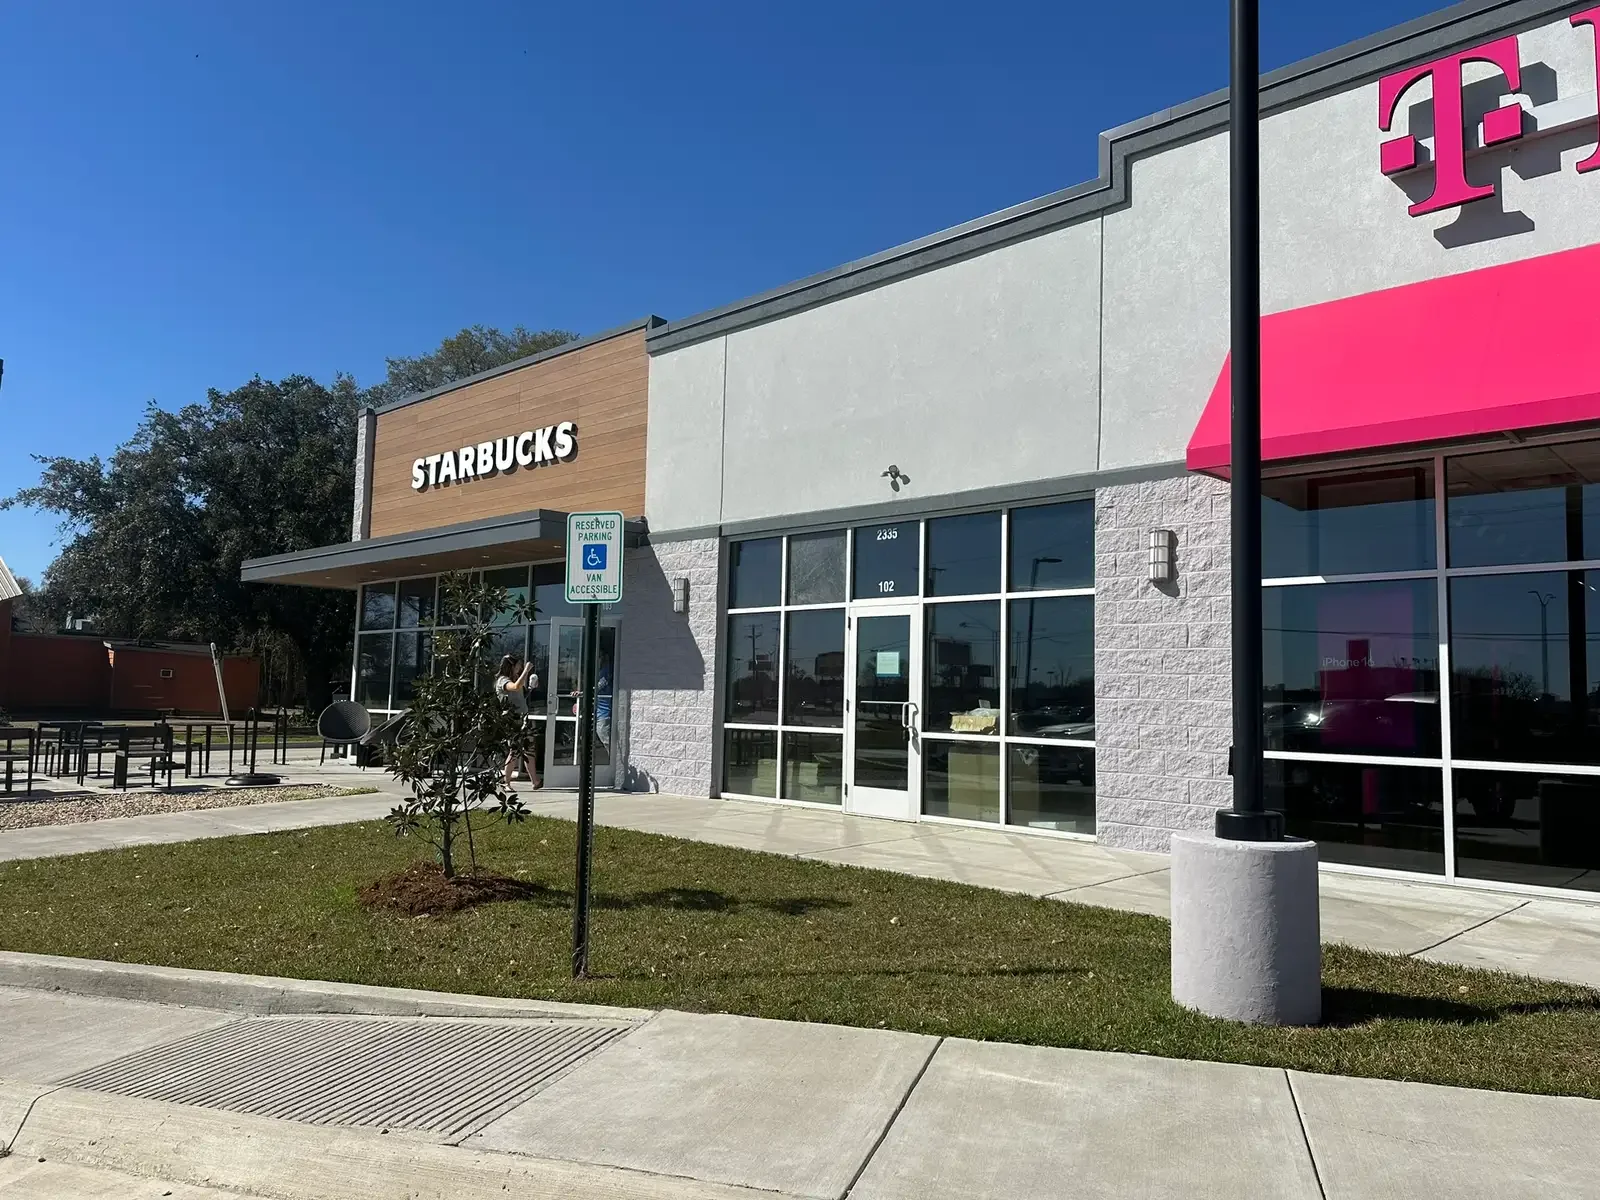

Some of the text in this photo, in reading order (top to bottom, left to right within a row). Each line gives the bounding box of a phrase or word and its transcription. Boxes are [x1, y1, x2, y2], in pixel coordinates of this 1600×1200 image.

[411, 421, 577, 490] STARBUCKS
[575, 520, 616, 530] RESERVED
[578, 531, 613, 541] PARKING
[876, 527, 898, 541] 2335
[586, 573, 602, 582] VAN
[570, 584, 618, 594] ACCESSIBLE
[878, 580, 895, 593] 102
[1322, 656, 1376, 667] iPhone 16
